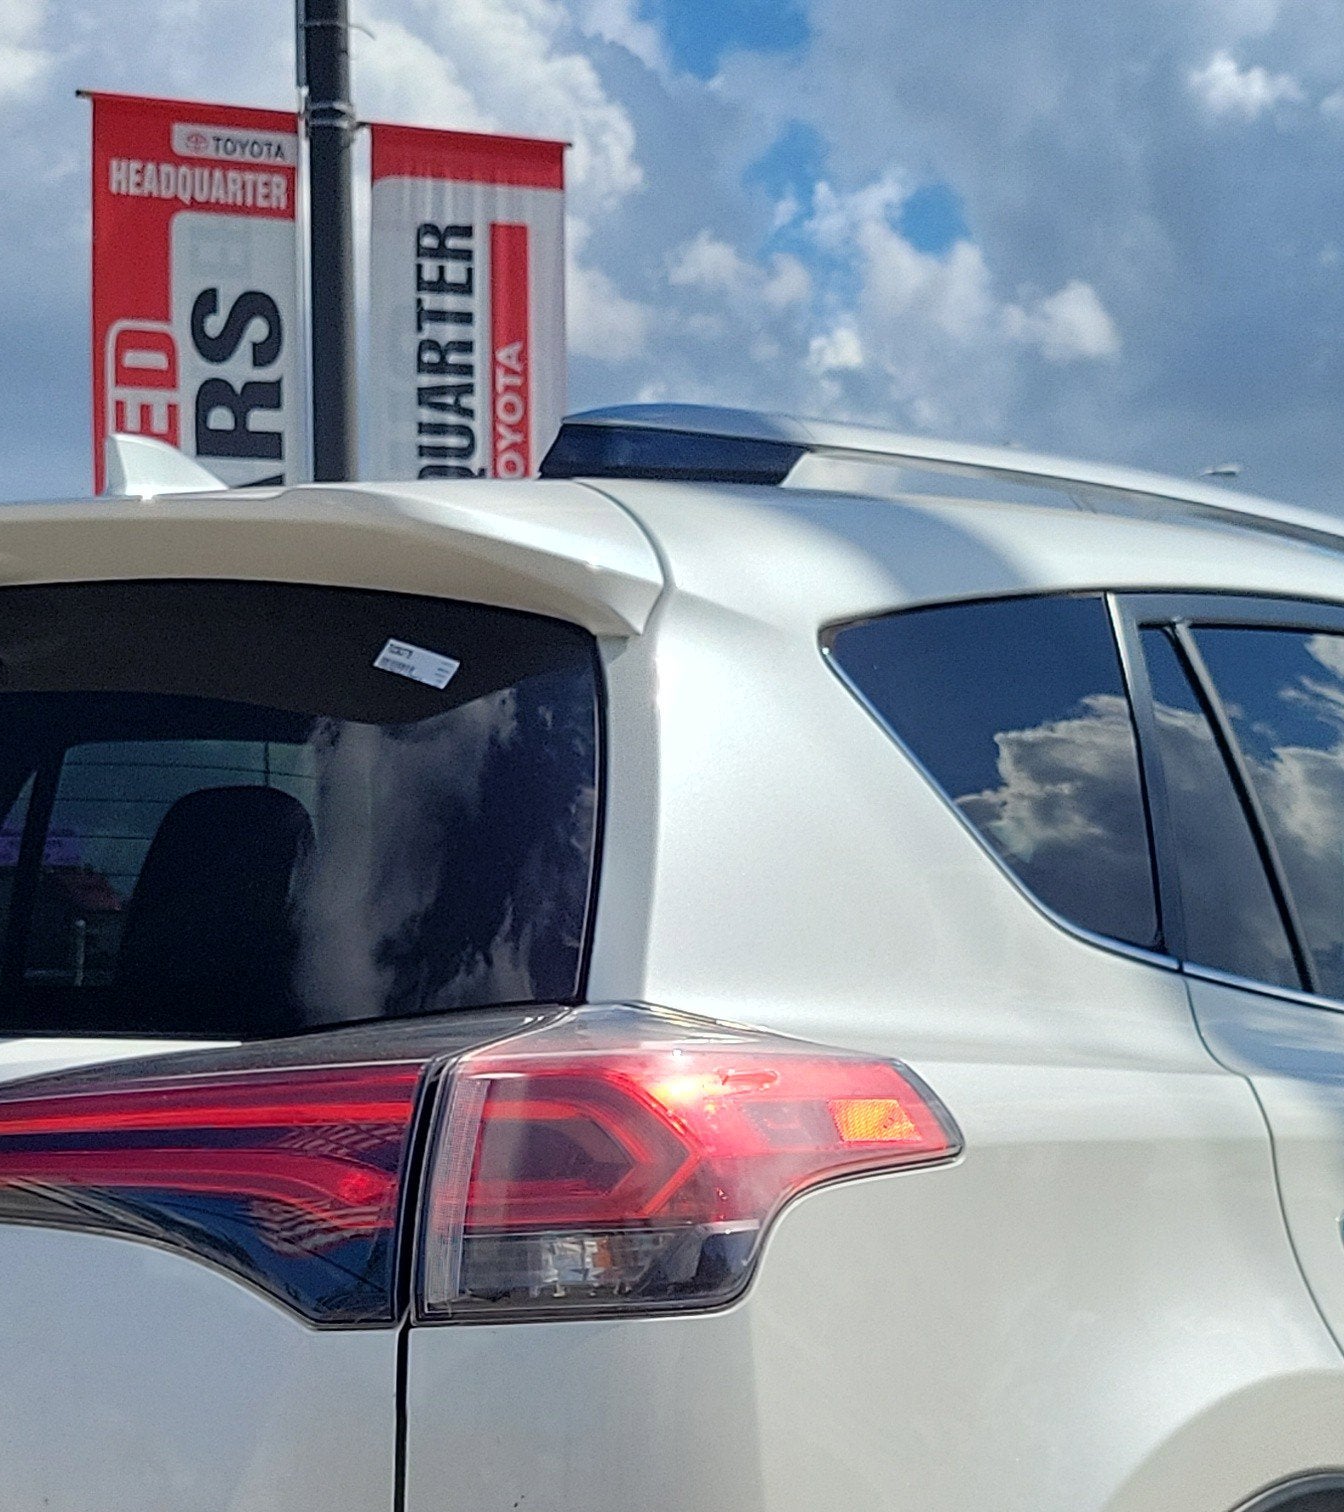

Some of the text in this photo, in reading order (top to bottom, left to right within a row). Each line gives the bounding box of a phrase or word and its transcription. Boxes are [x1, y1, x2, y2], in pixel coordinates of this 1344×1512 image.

[109, 157, 288, 209] HEADQUARTER
[212, 136, 285, 160] TOYOTA
[114, 327, 179, 447] ED
[190, 286, 286, 485] RS
[416, 222, 480, 478] UARTER
[496, 341, 527, 478] OYOTA
